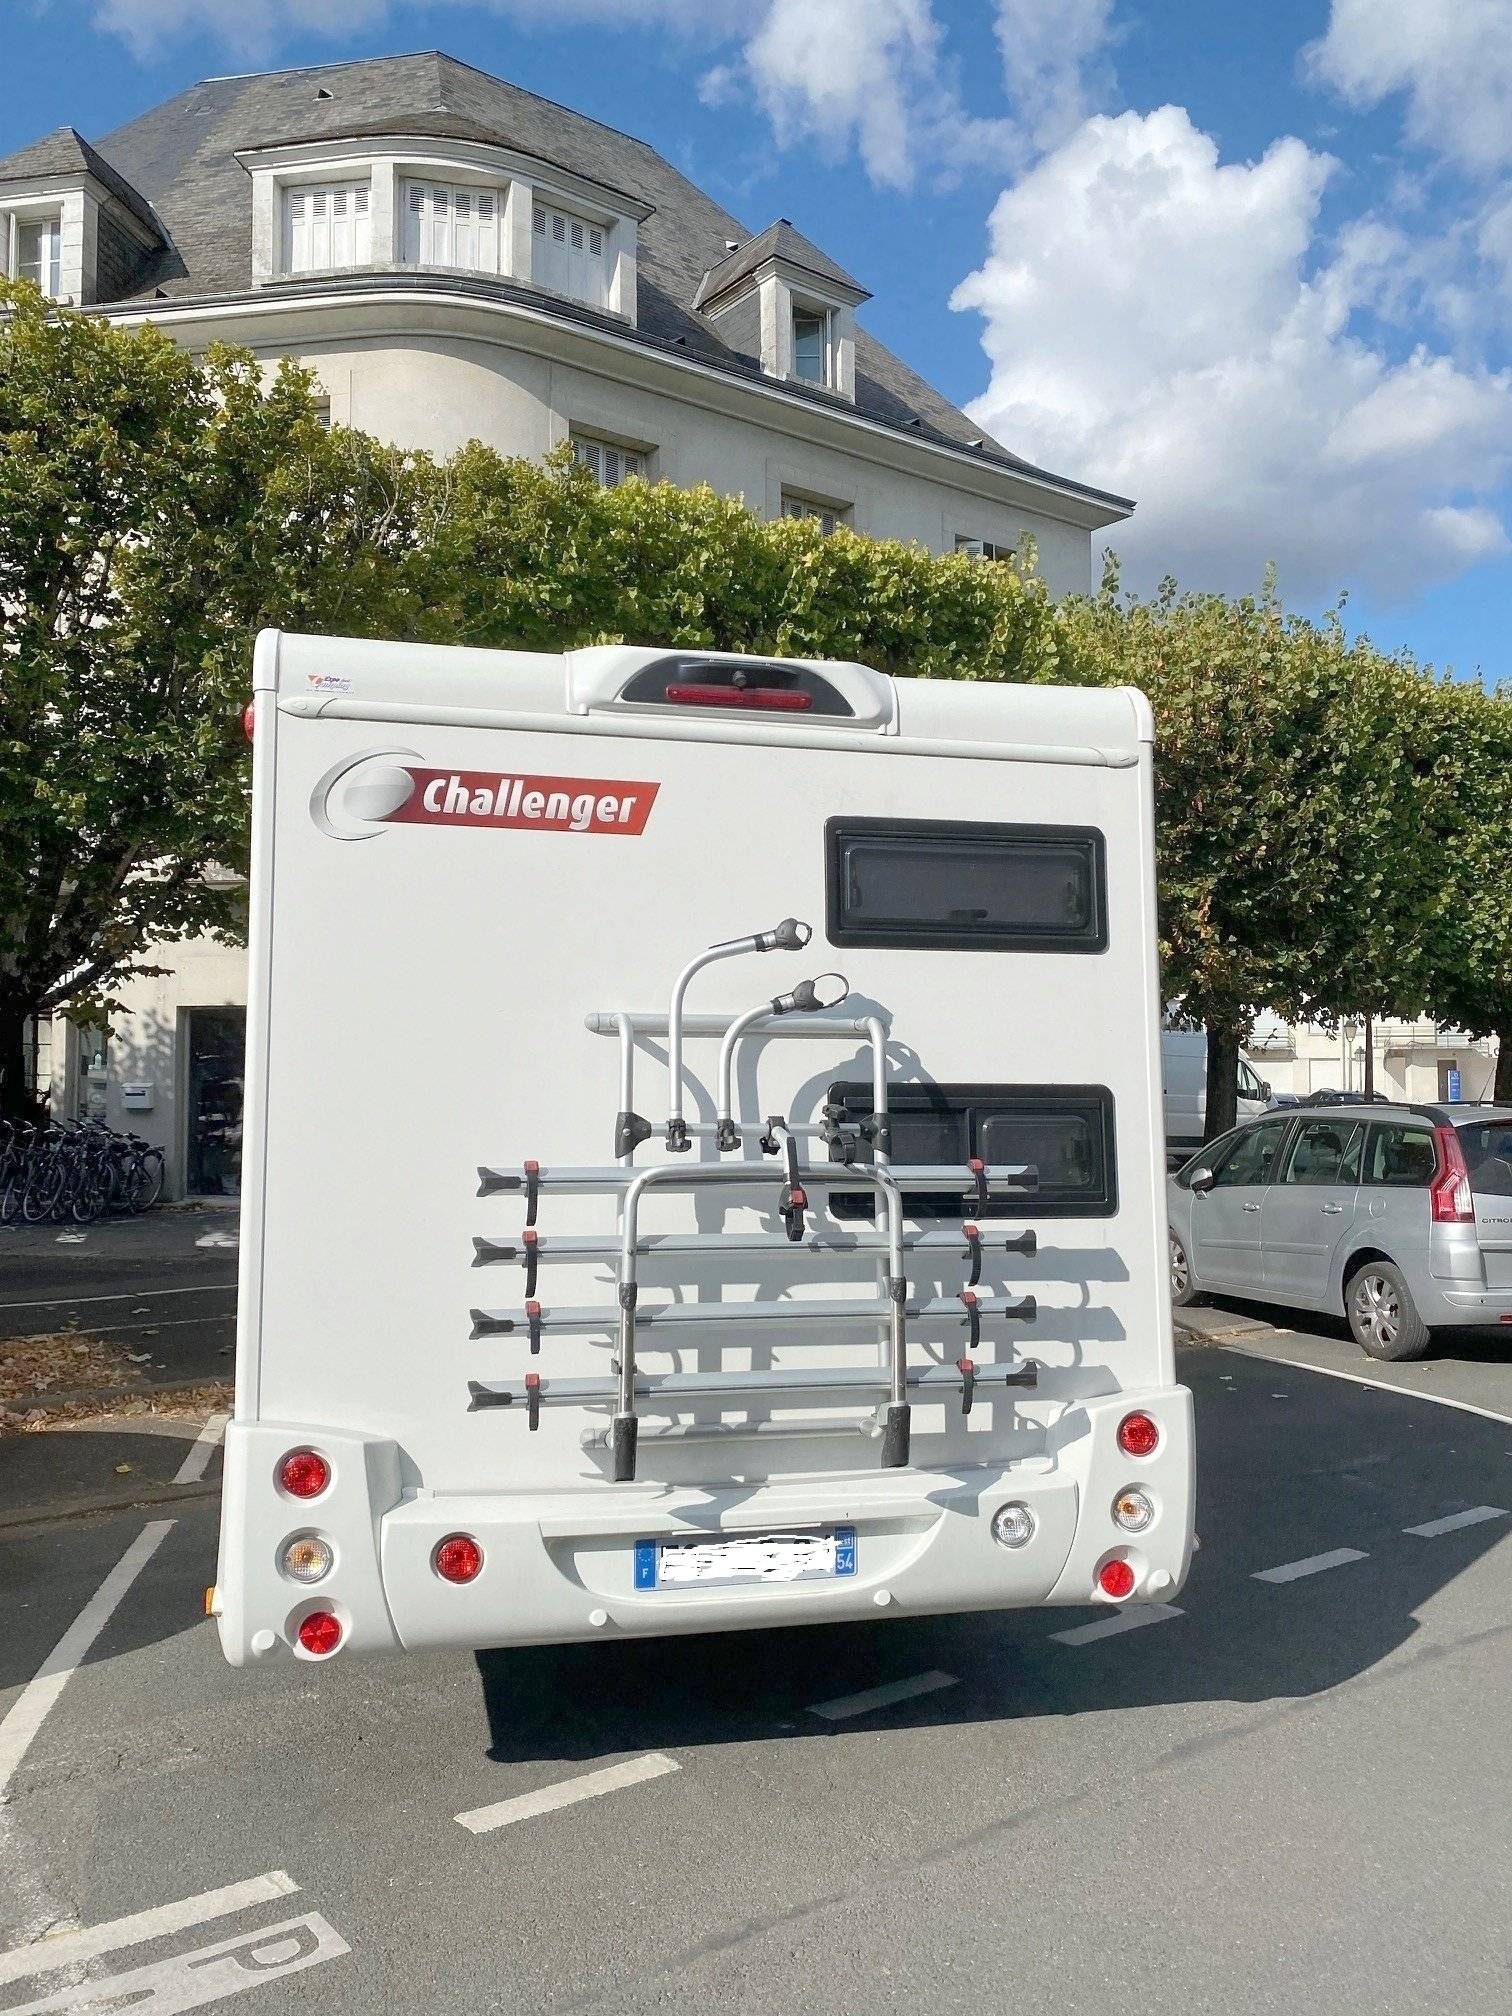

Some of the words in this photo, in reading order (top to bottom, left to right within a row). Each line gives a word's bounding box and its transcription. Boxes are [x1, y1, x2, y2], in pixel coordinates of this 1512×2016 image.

[423, 776, 636, 831] Challenger
[837, 1552, 853, 1570] 54
[642, 1567, 649, 1579] F
